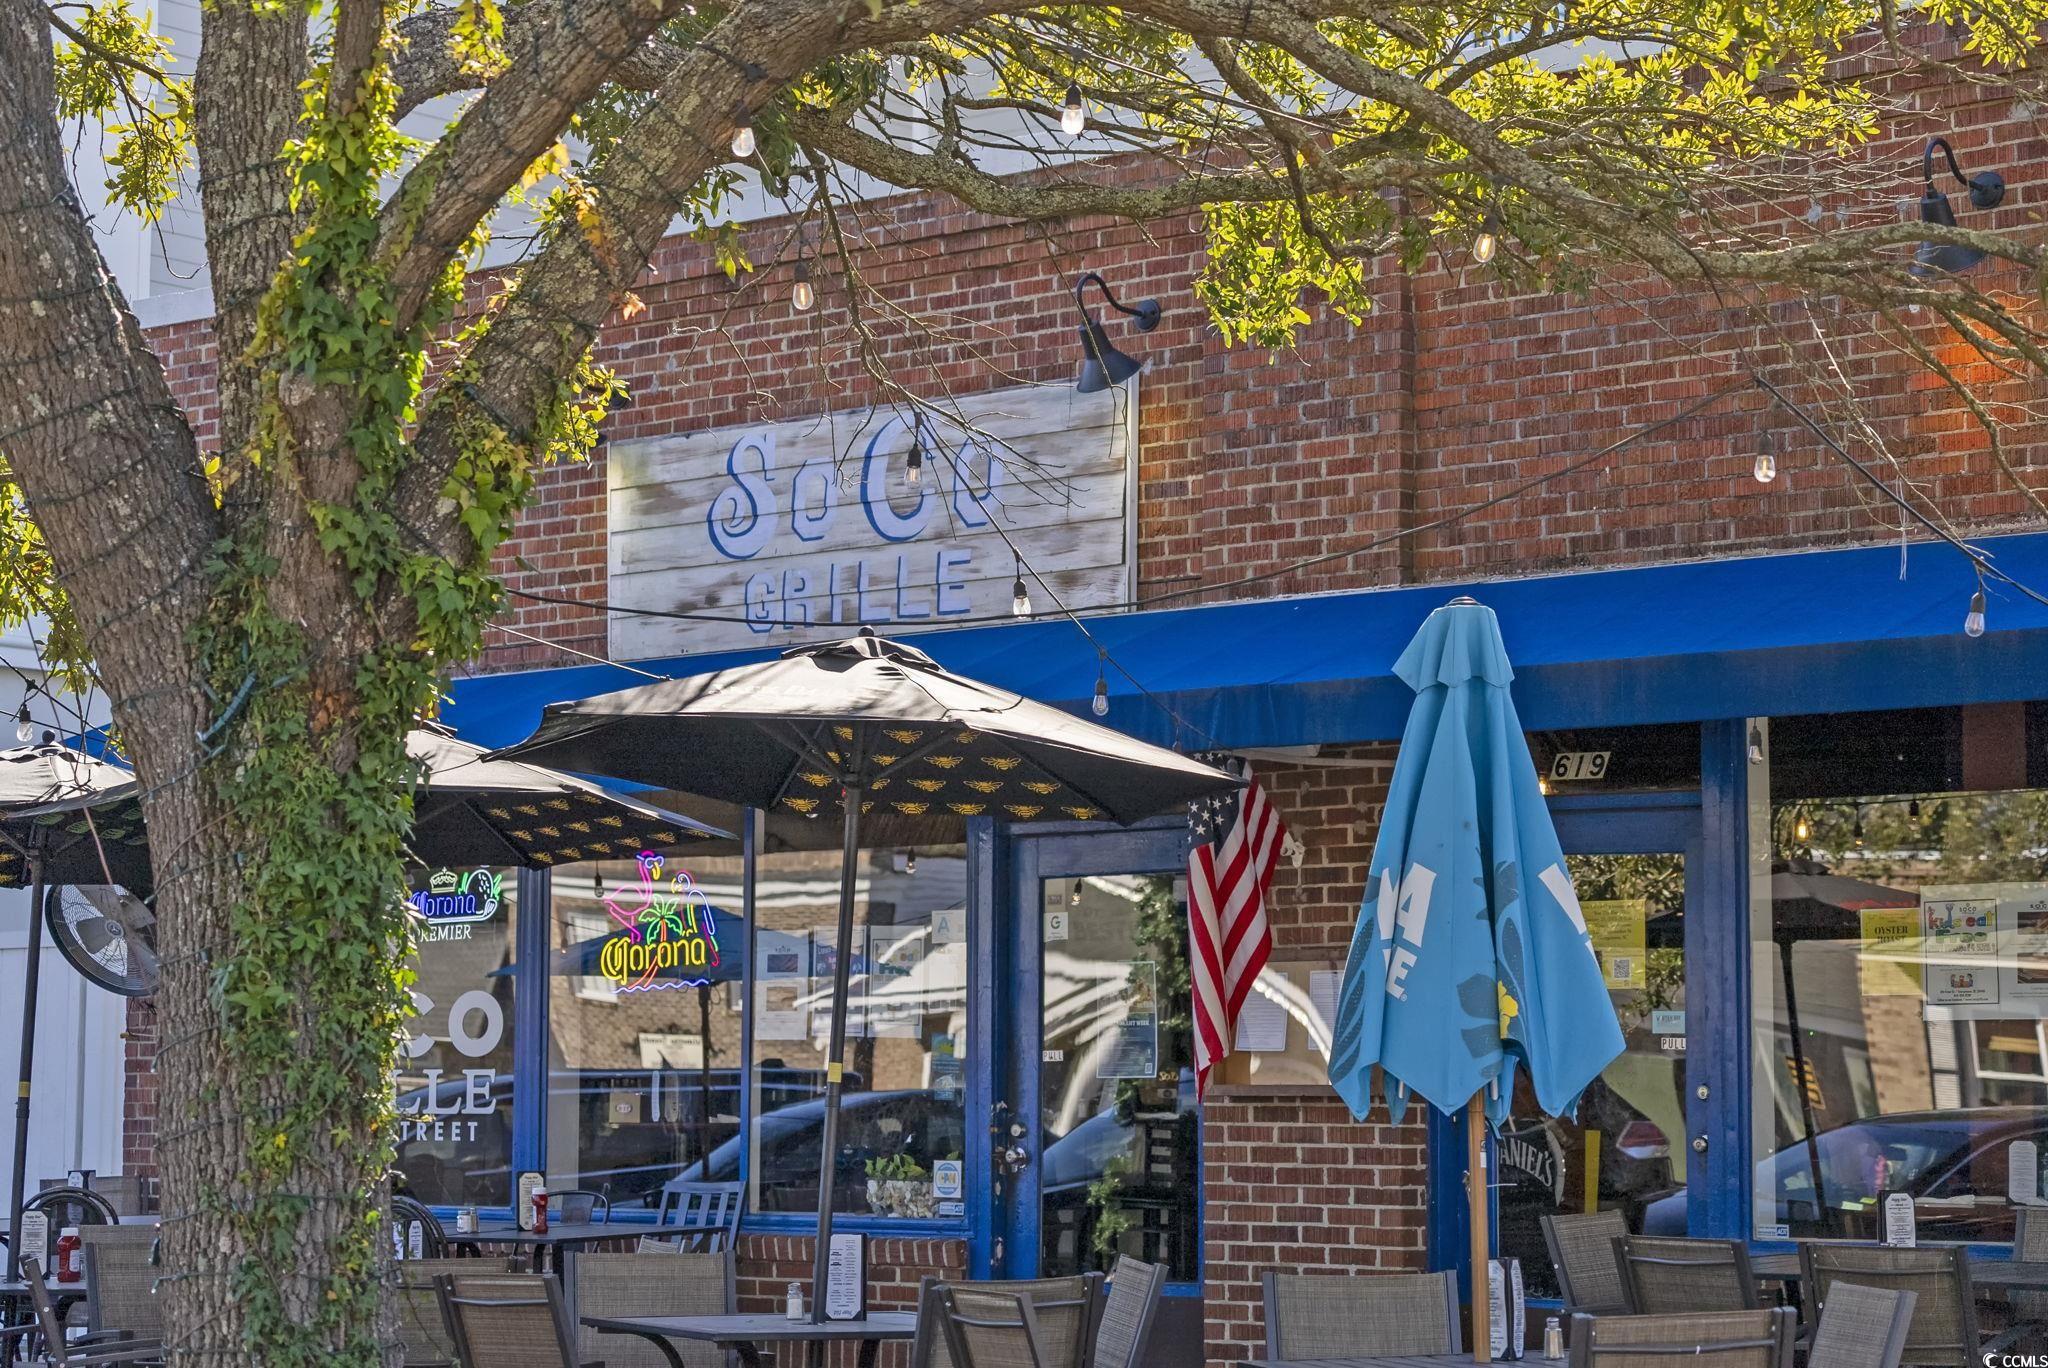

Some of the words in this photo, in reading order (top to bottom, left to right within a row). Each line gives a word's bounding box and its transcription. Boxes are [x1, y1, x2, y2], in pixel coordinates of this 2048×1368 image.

[744, 549, 972, 634] GRILLE
[1555, 754, 1605, 778] 619
[408, 891, 476, 917] Corona
[419, 925, 472, 943] REMIER
[1874, 925, 1909, 935] OYSTER
[601, 937, 705, 985] Corona
[393, 990, 504, 1058] CO
[1043, 1050, 1063, 1061] PULL
[1661, 1038, 1686, 1049] PULL
[393, 1068, 496, 1115] LLE
[401, 1121, 478, 1142] TREET
[1500, 1136, 1553, 1187] ANIEL'S
